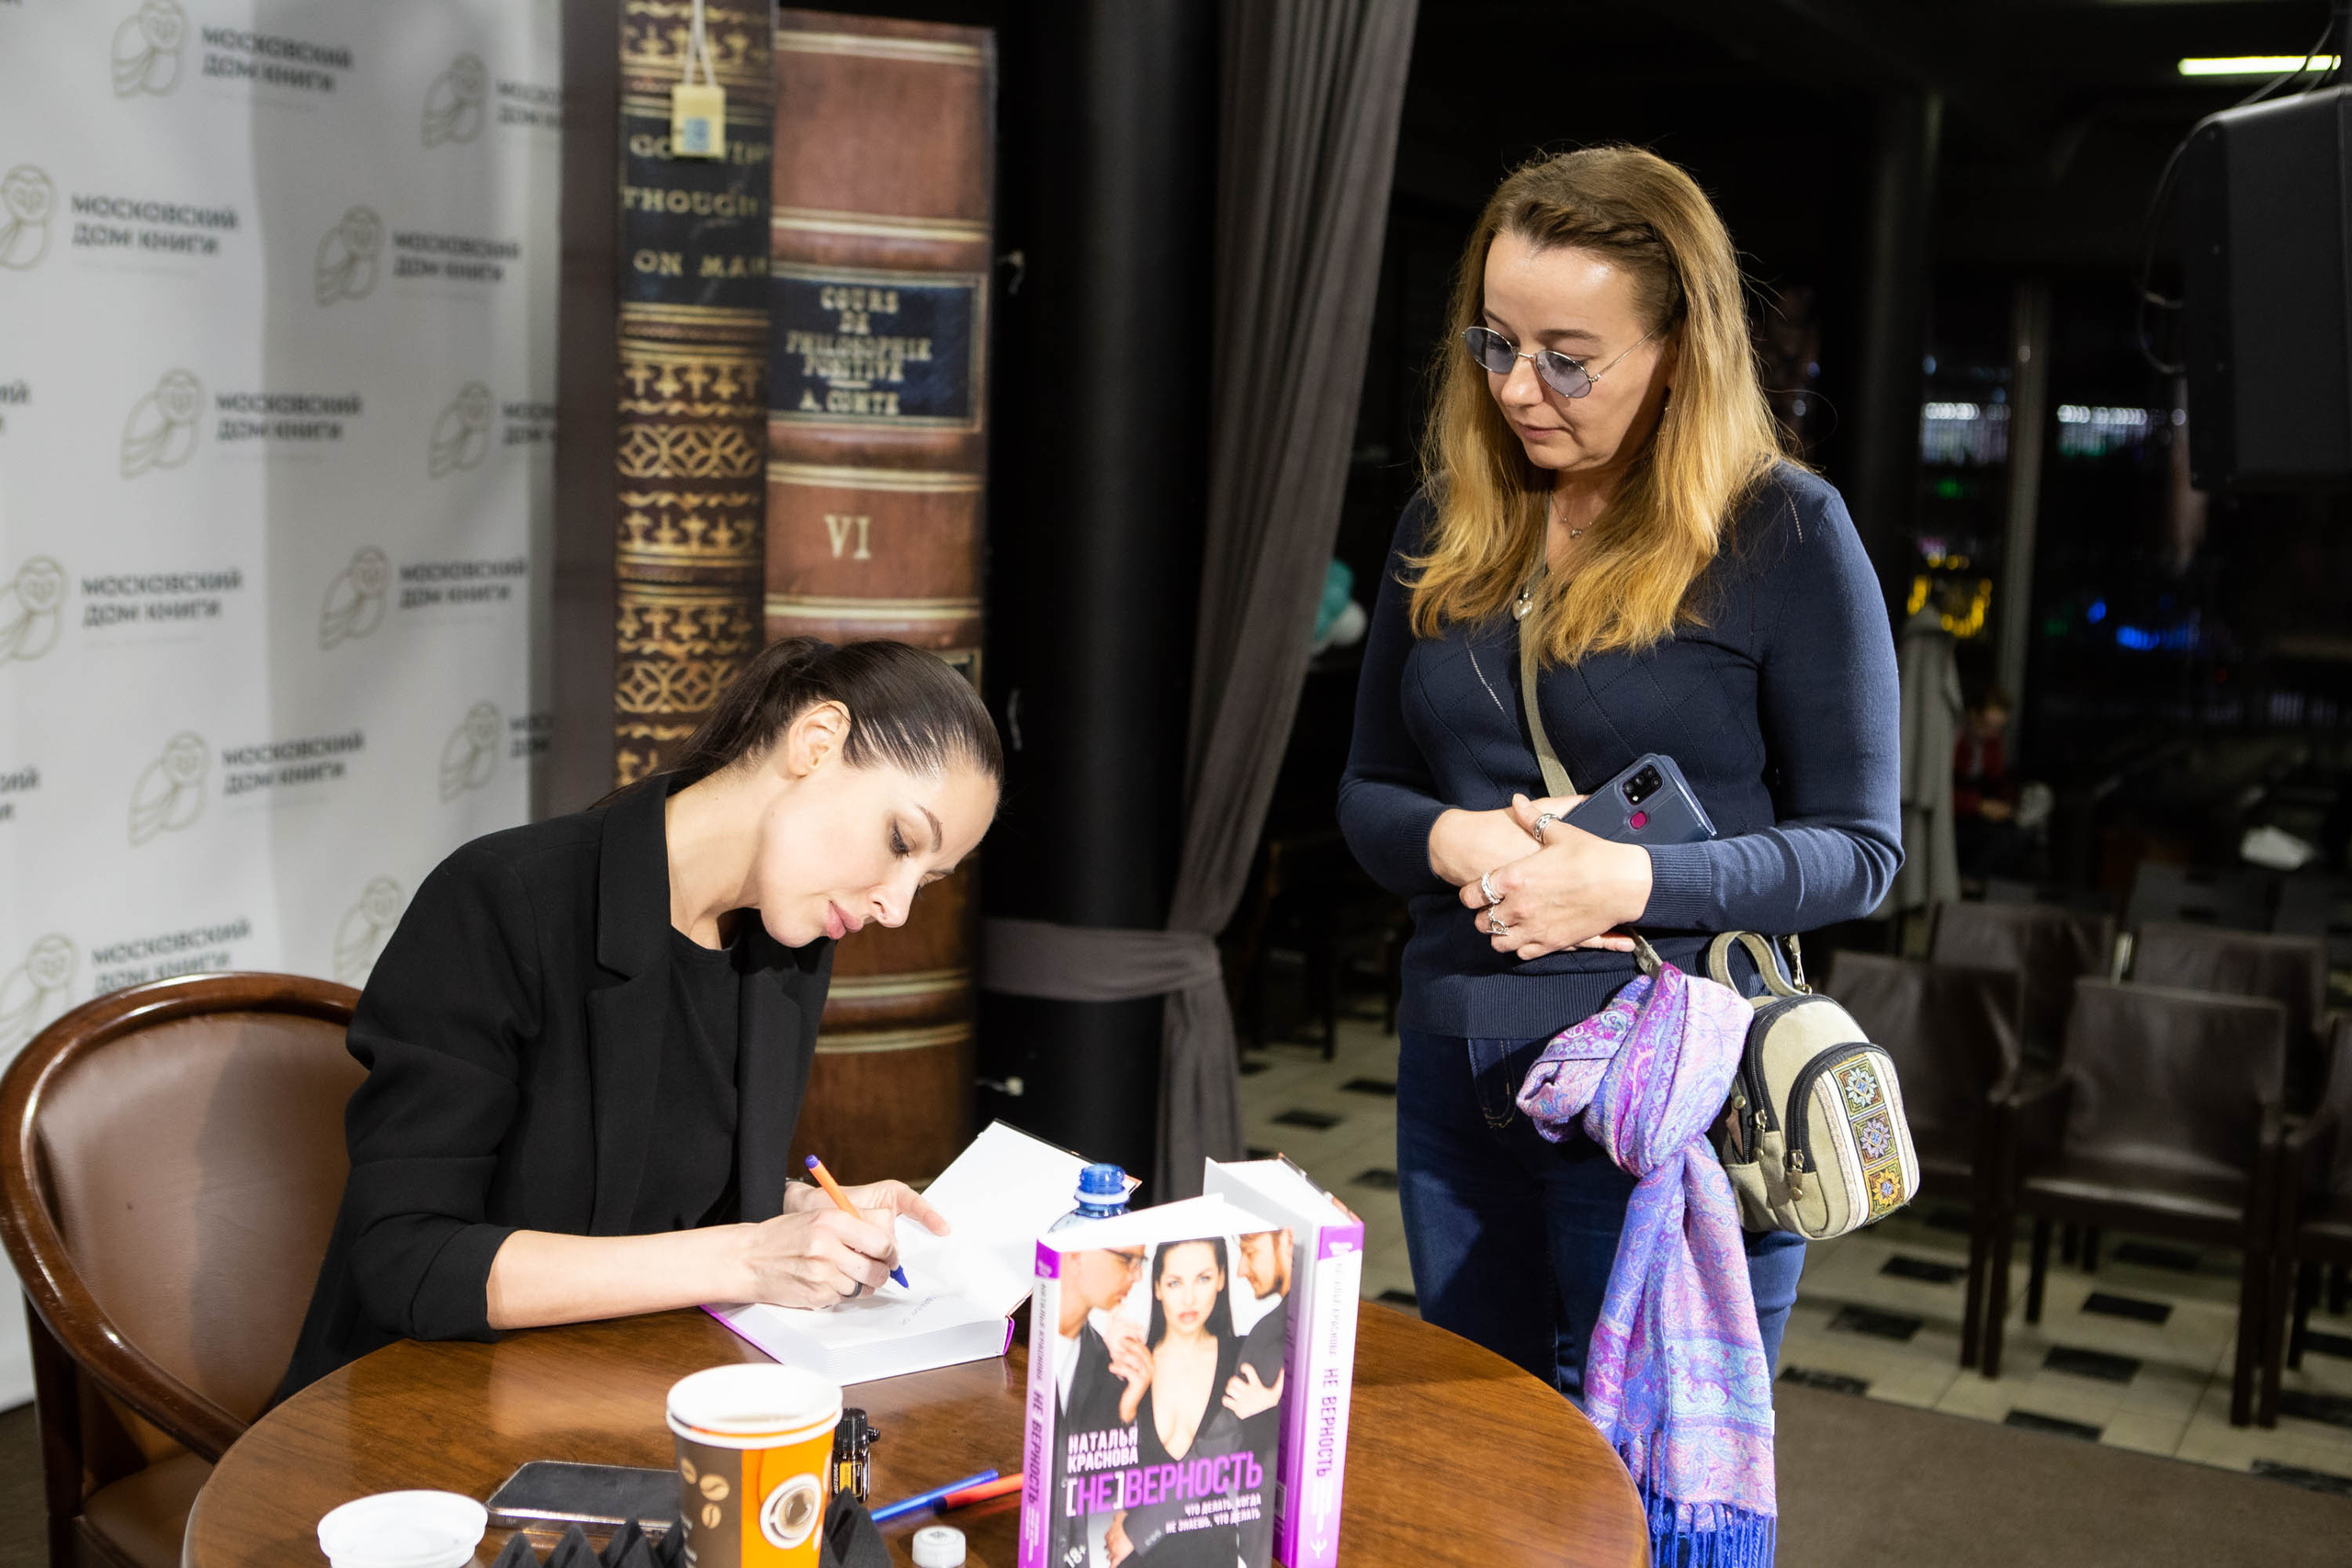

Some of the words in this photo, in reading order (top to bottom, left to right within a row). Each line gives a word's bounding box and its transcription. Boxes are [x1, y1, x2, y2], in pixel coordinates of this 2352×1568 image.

[201, 27, 353, 70] МОСКОВСКИЙ
[201, 55, 256, 79] ДОМ
[264, 62, 335, 93] КНИГИ
[72, 195, 239, 231] МОСКОВСКИЙ
[73, 223, 133, 248] ДОМ
[139, 229, 220, 255] КНИГИ
[393, 231, 521, 261] МОСКОВСКИЙ
[394, 256, 439, 278] ДОМ
[446, 261, 505, 282] КНИГИ
[633, 248, 683, 276] ON
[216, 392, 363, 417] МОСКОВСКИЙ
[217, 419, 266, 442] ДОМ
[272, 420, 343, 442] КНИГИ
[824, 513, 871, 559] VI
[83, 567, 243, 596] МОСКОВСКИЙ
[400, 557, 527, 581] МОСКОВСКИЙ
[401, 585, 444, 607] ДОМ
[449, 583, 511, 604] КНИГИ
[84, 600, 140, 626] ДОМ
[146, 598, 222, 621] КНИГИ
[222, 730, 365, 766] МОСКОВСКИЙ
[224, 767, 275, 795] ДОМ
[280, 760, 345, 786] КНИГИ
[92, 919, 252, 964] МОСКОВСКИЙ
[94, 968, 150, 994] ДОМ
[154, 950, 230, 976] КНИГИ
[1323, 1368, 1339, 1389] НЕ
[1032, 1392, 1044, 1416] НЕ
[1068, 1426, 1138, 1454] НАТАЛЬЯ
[1317, 1395, 1338, 1478] ВЕРНОСТЬ
[1028, 1419, 1043, 1505] ВЕРНОСТЬ
[1067, 1445, 1138, 1473] КРАСНОВА
[1165, 1520, 1177, 1534] НЕ
[1213, 1510, 1229, 1526] ЧТО
[1229, 1506, 1261, 1524] ДЕЛАТЬ
[1184, 1502, 1201, 1517] ЧТО
[1063, 1545, 1087, 1568] 18+
